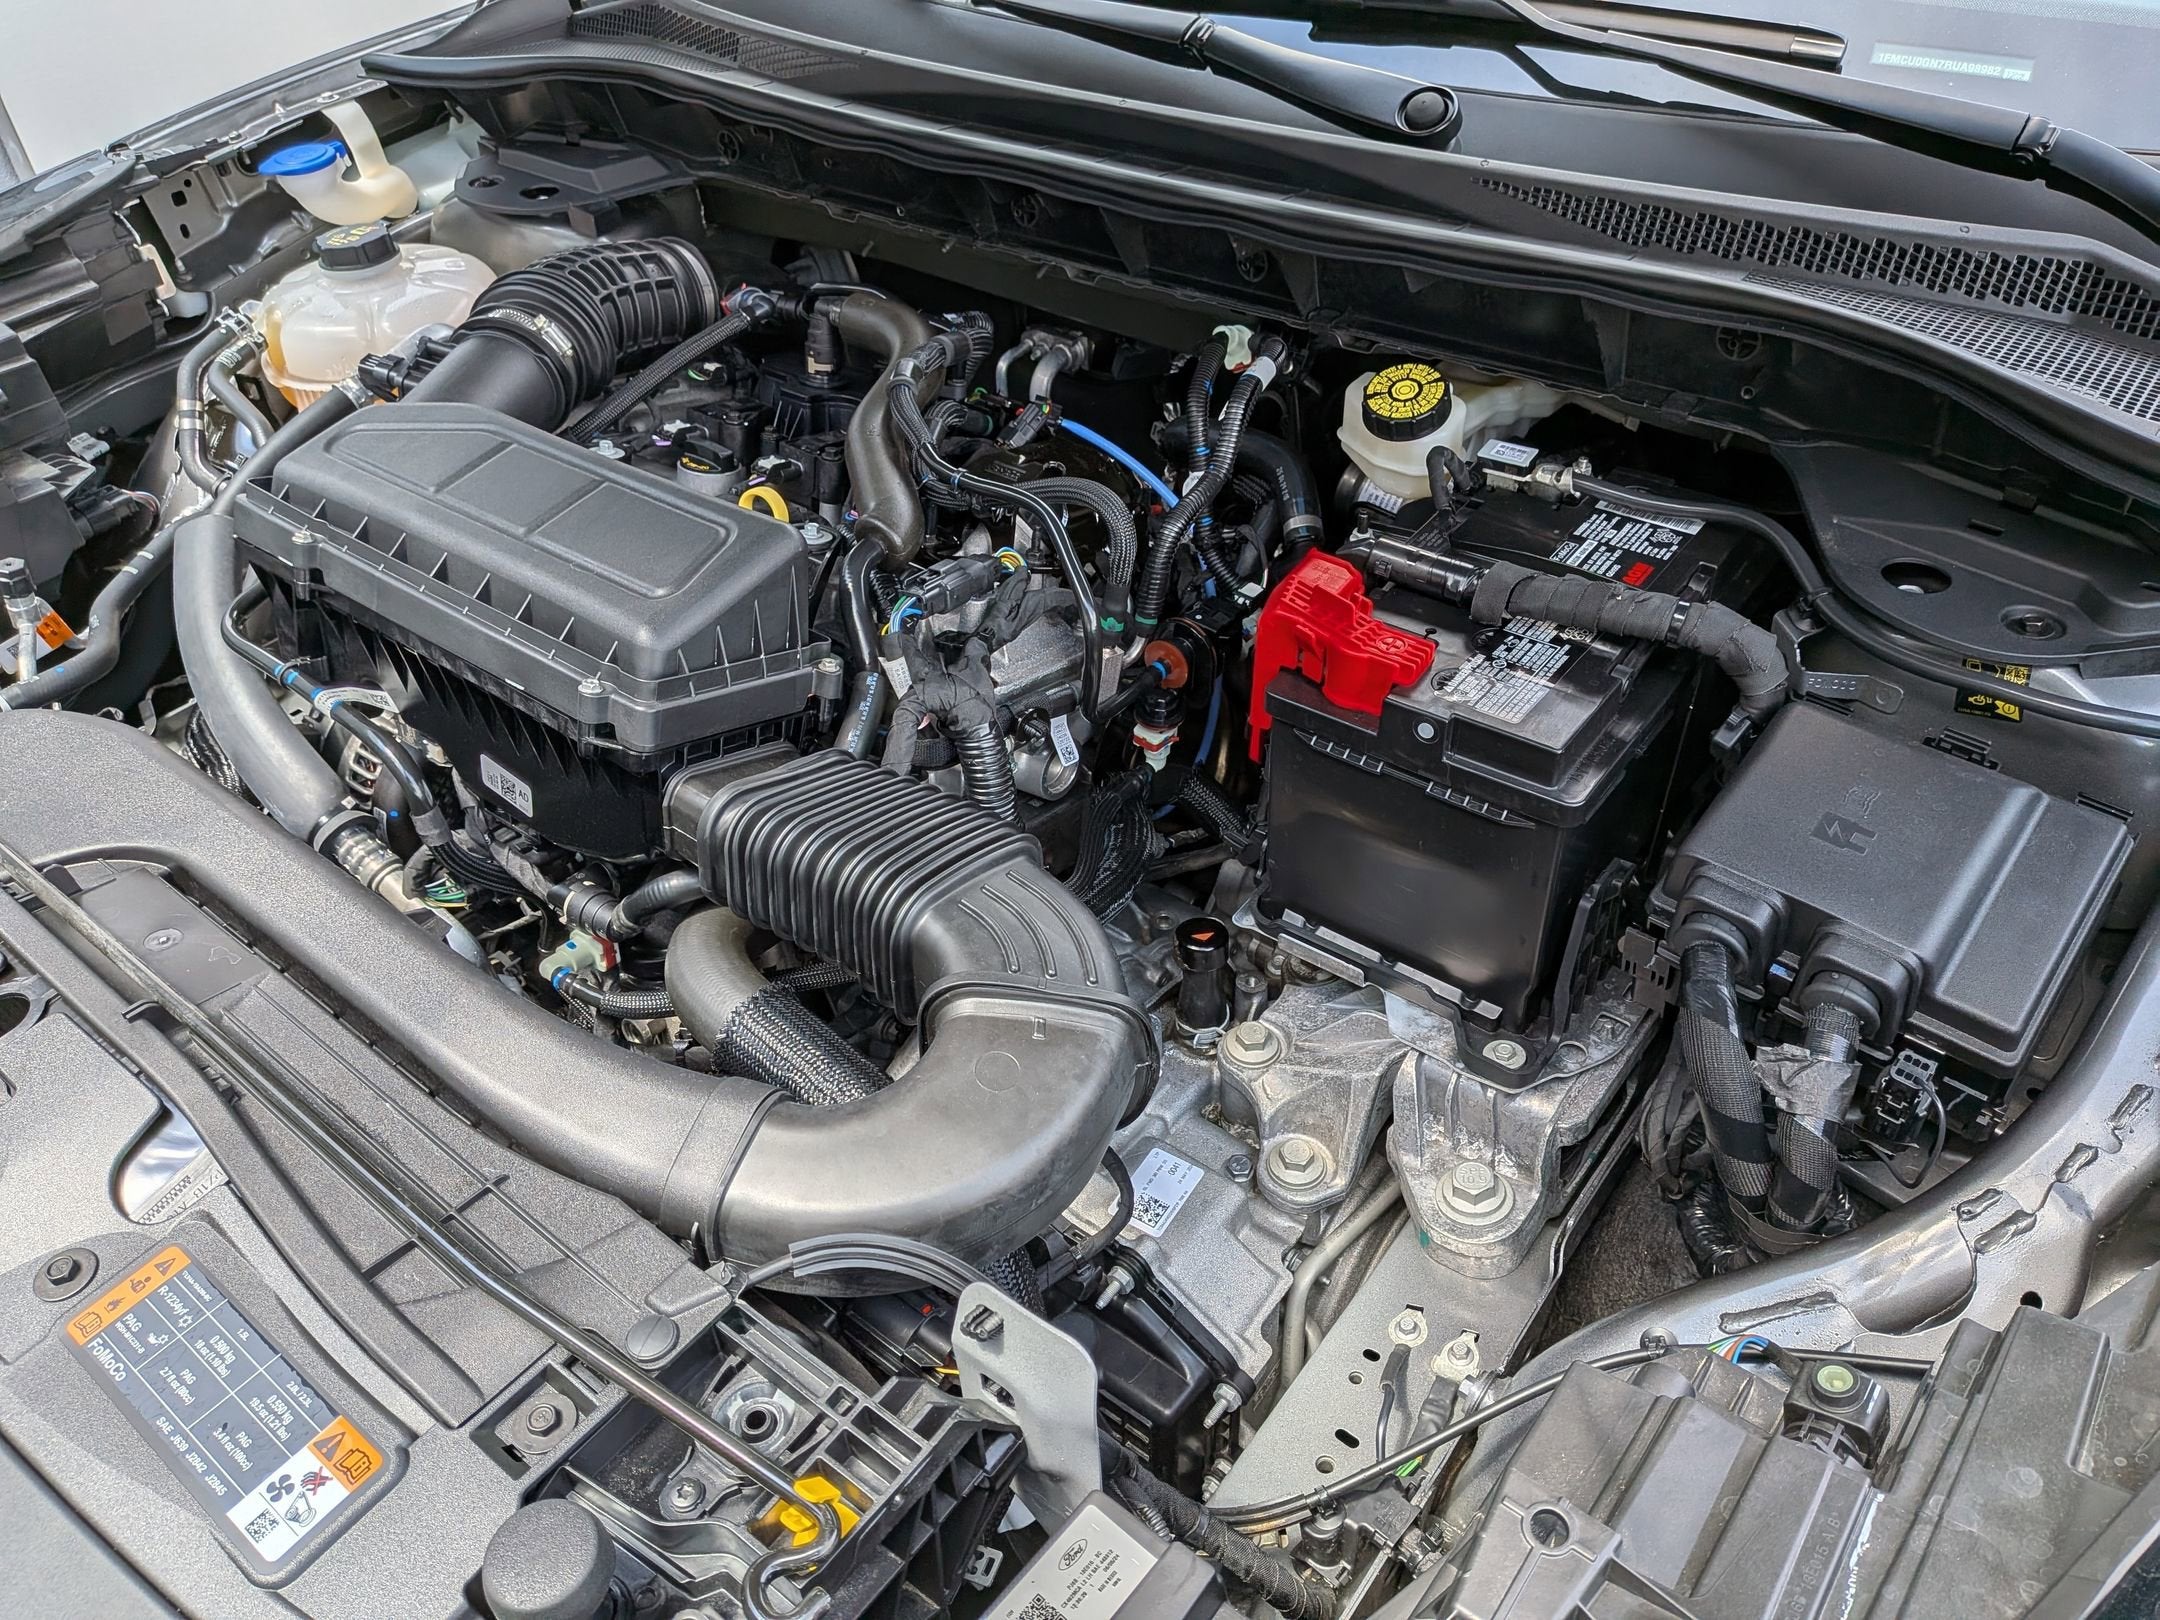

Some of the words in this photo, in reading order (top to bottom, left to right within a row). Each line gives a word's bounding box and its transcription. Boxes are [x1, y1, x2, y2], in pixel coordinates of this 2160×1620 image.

[1556, 543, 1574, 562] FoMoCo
[518, 789, 529, 803] AD
[158, 1285, 189, 1315] R-1234yf
[123, 1313, 142, 1332] PAG
[237, 1328, 249, 1341] 1.5L
[210, 1335, 230, 1354] 0.500
[224, 1350, 236, 1364] kg
[88, 1338, 126, 1381] FoMoCo
[200, 1347, 209, 1356] oz
[217, 1363, 231, 1378] lbs)
[159, 1367, 172, 1377] 2.7
[170, 1380, 180, 1389] oz
[180, 1369, 196, 1384] PAG
[249, 1397, 264, 1411] 19.5
[259, 1409, 269, 1418] oz
[267, 1395, 287, 1414] 0.550
[280, 1408, 294, 1425] kg
[263, 1414, 284, 1430] (1.21
[235, 1431, 252, 1447] PAG
[276, 1426, 291, 1441] lbs)
[156, 1417, 174, 1434] SAE
[170, 1434, 189, 1451] J639
[185, 1452, 207, 1473] J2842
[205, 1474, 227, 1495] J2845
[213, 1428, 226, 1440] 3.4
[224, 1442, 234, 1451] oz
[229, 1447, 253, 1471] (100cc)
[1063, 1544, 1083, 1567] Ford
